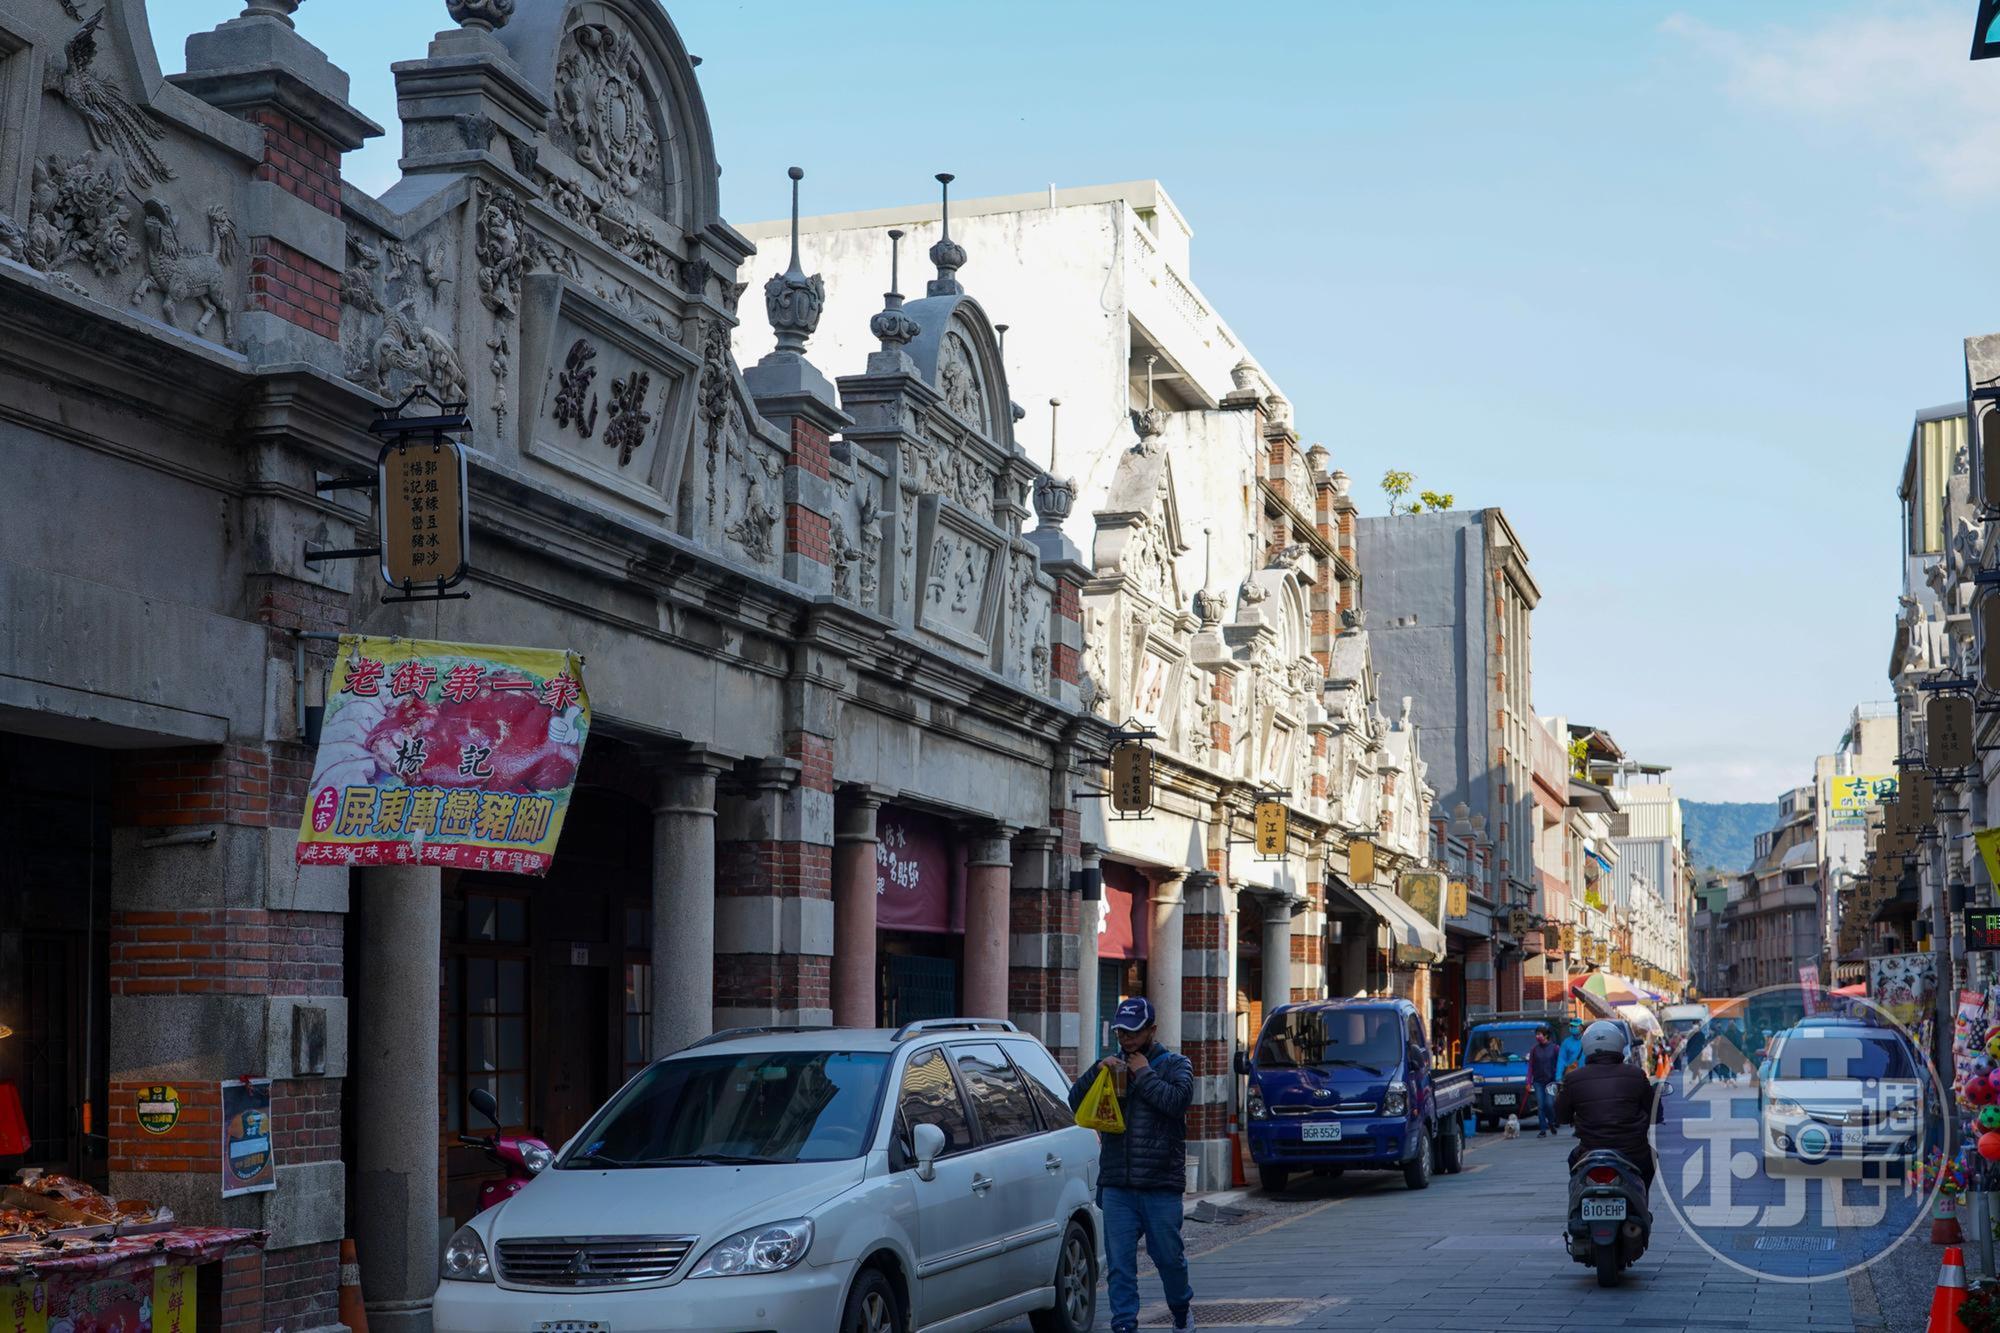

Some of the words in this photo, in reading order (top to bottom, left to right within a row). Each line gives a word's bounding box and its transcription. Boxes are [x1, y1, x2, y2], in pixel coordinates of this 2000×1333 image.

[410, 461, 425, 566] 楊記萬巒豬腳
[424, 460, 440, 566] 郭姐綠豆冰沙
[341, 657, 582, 711] 老街第一家
[394, 740, 495, 777] 楊記
[315, 791, 334, 831] 正宗
[336, 785, 554, 844] 屏東萬巒豬腳
[1265, 821, 1277, 849] 江家
[1583, 1205, 1625, 1216] 810-EHP
